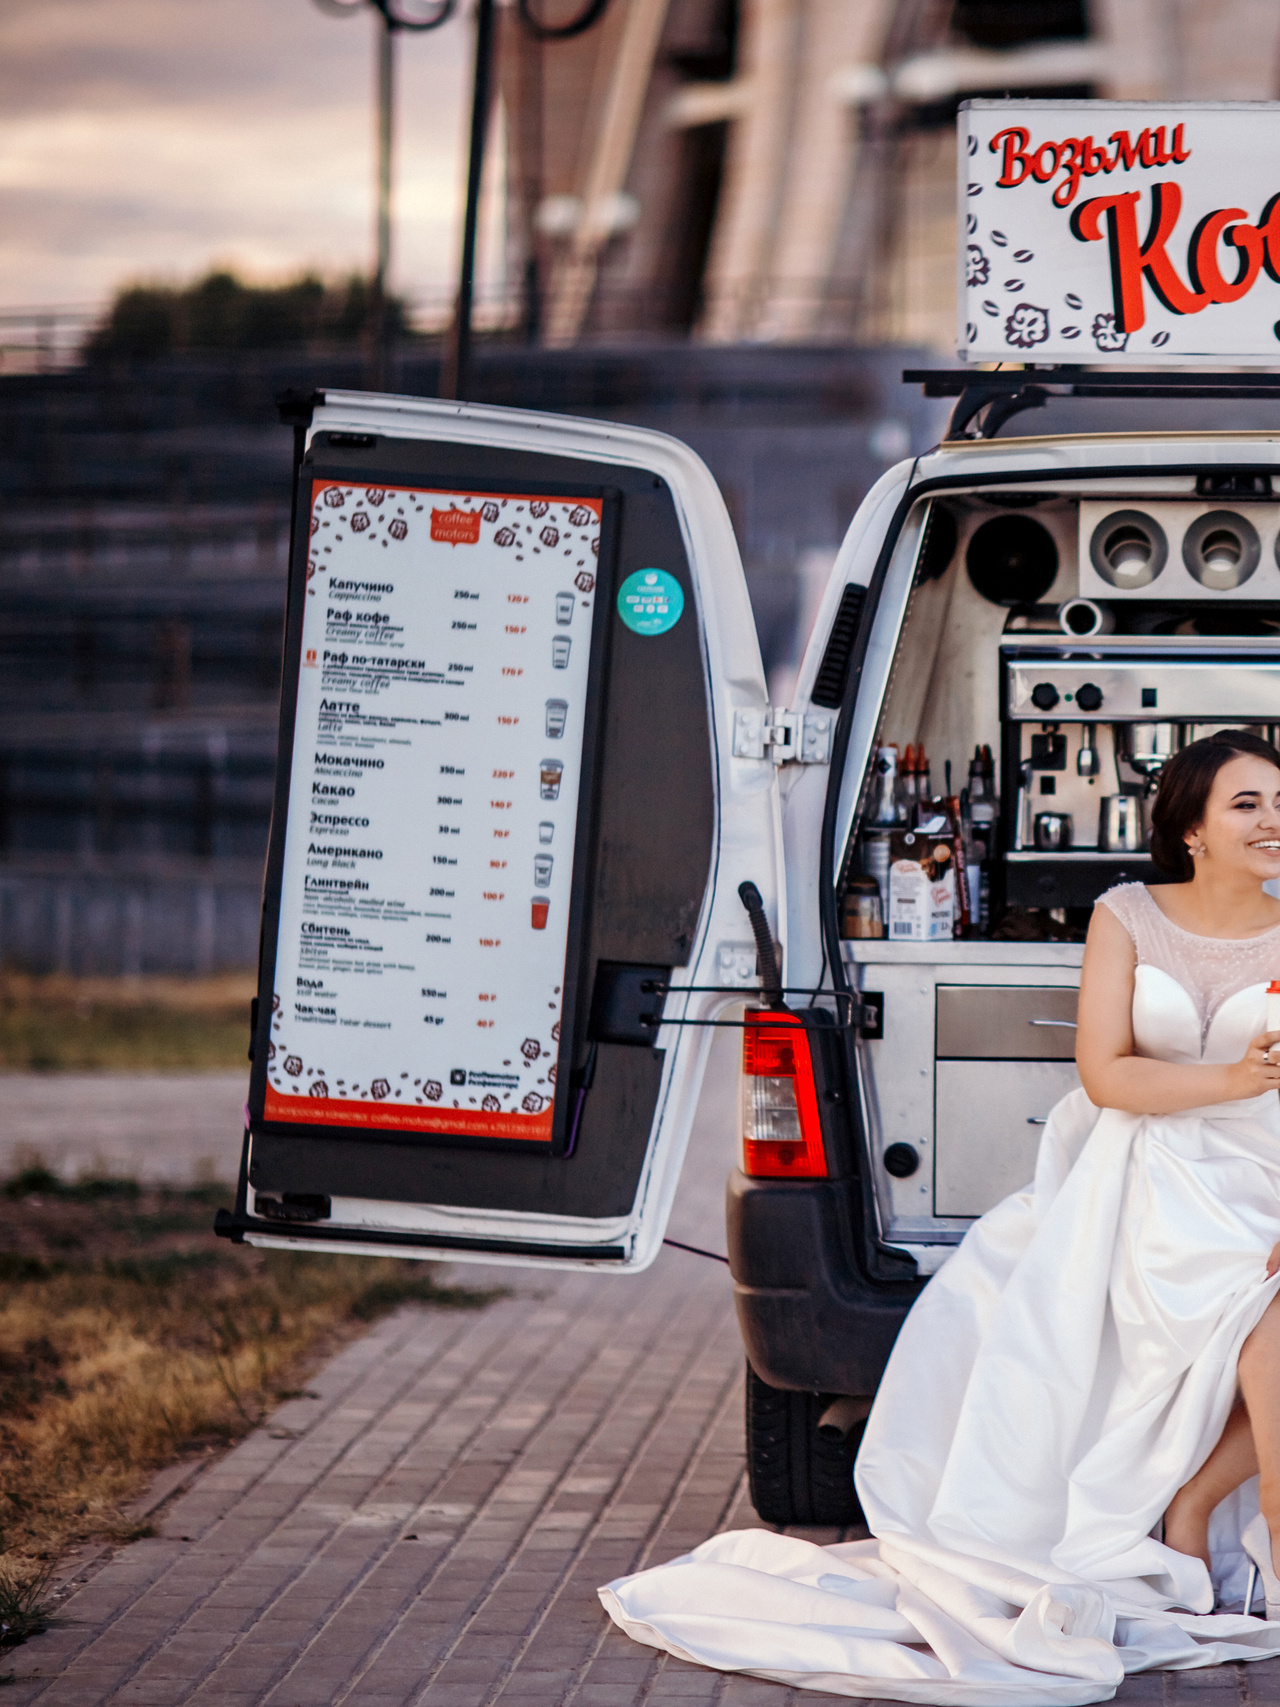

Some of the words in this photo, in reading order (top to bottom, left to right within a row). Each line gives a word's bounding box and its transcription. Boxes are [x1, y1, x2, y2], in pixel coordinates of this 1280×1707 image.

[990, 123, 1192, 208] Возьми
[438, 511, 473, 525] coffee
[434, 528, 476, 541] motors
[329, 577, 394, 593] Капучино
[328, 591, 382, 603] Cappuccino
[327, 608, 352, 623] Раф
[356, 611, 390, 627] кофе
[323, 651, 348, 666] Раф
[352, 655, 425, 671] по-татарски
[320, 699, 360, 713] Латте
[315, 752, 385, 769] Мокачино
[312, 782, 355, 797] Какао
[310, 811, 369, 828] Эспрессо
[307, 842, 383, 861] Американо
[304, 874, 369, 891] Глинтвейн
[301, 922, 350, 937] Сбитень
[297, 977, 323, 989] Вода
[295, 1003, 336, 1015] Чак-чак
